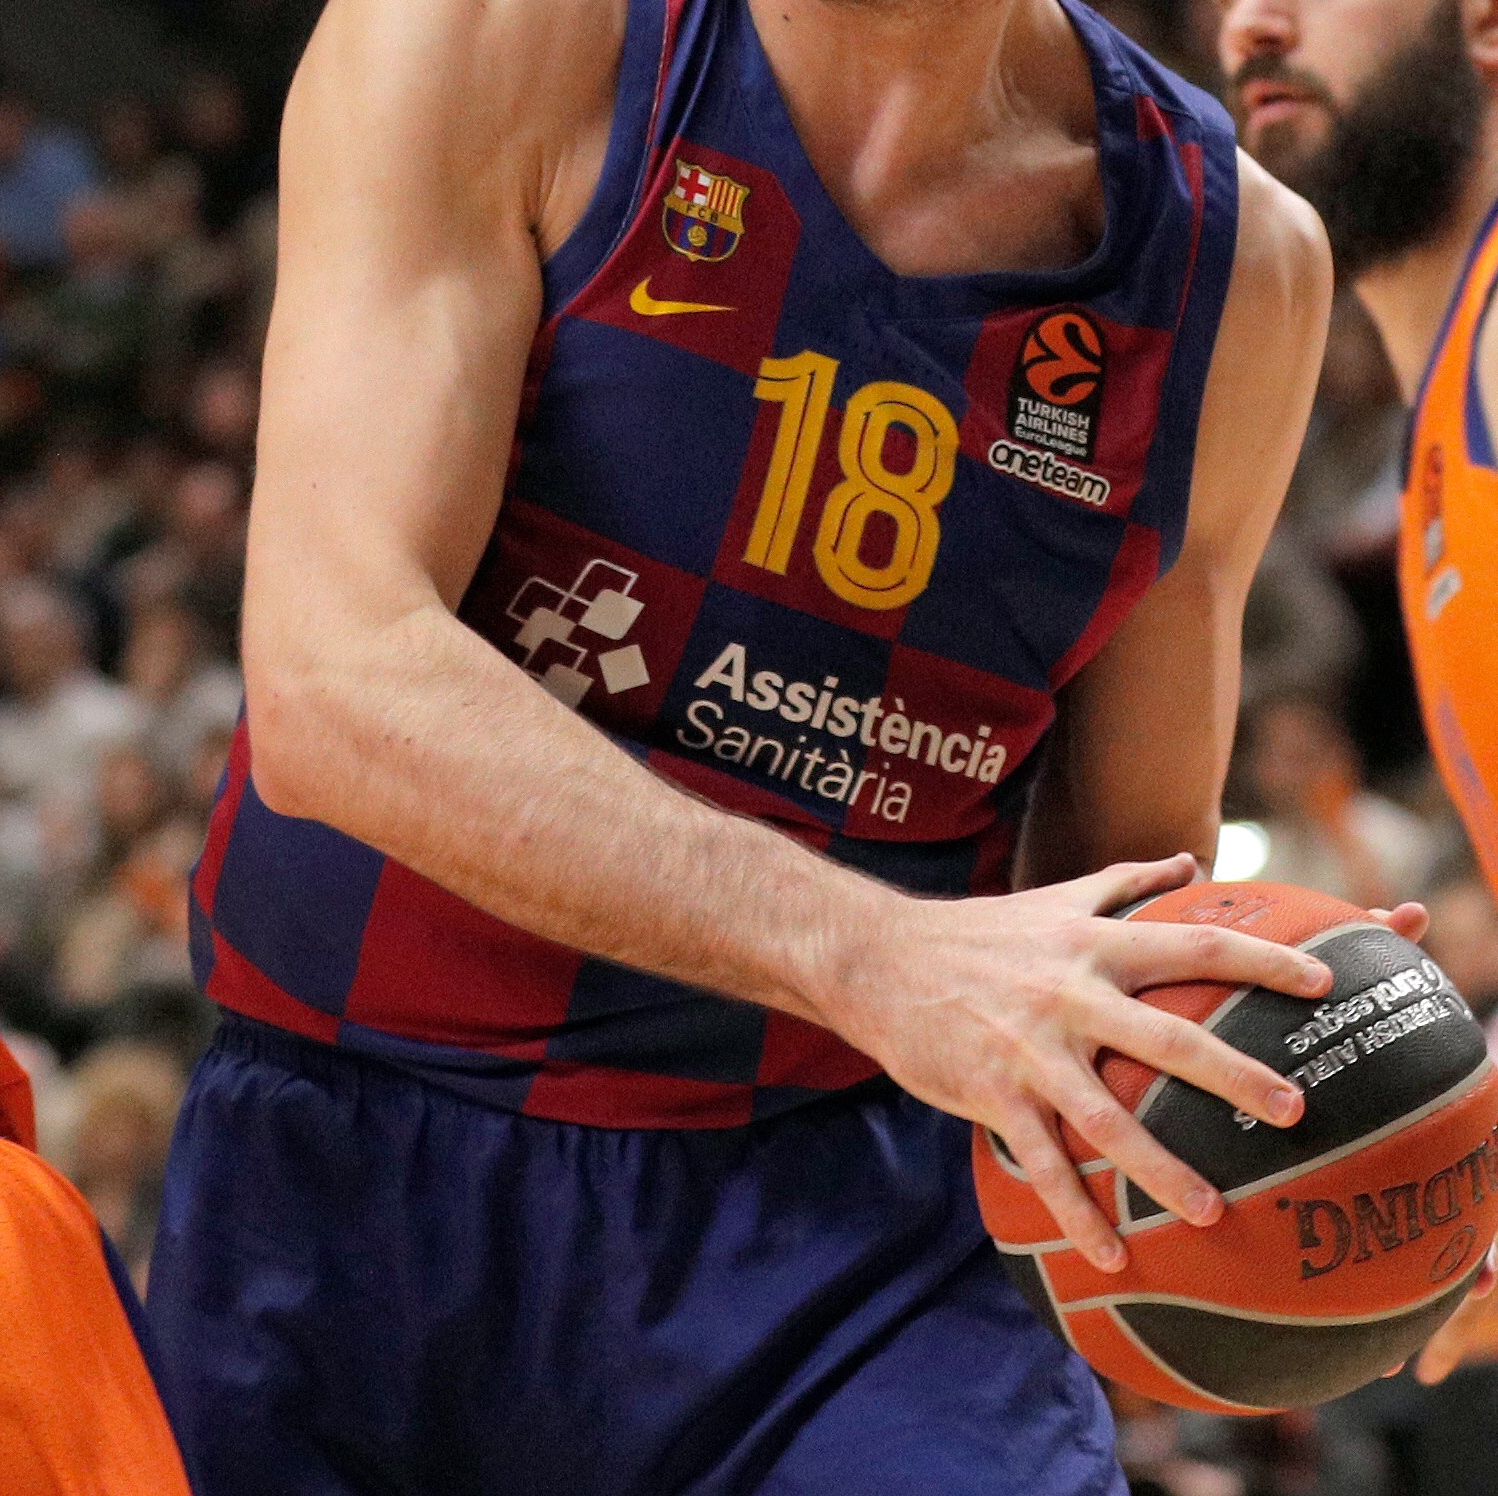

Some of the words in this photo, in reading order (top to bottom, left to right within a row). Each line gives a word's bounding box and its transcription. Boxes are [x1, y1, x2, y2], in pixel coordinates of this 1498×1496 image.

[1015, 413, 1089, 445] AIRLINES
[1017, 396, 1090, 430] TURKISH
[741, 349, 961, 611] 18
[990, 442, 1108, 504] oneteam
[693, 642, 1008, 785] Assistència
[675, 699, 914, 824] Sanitària
